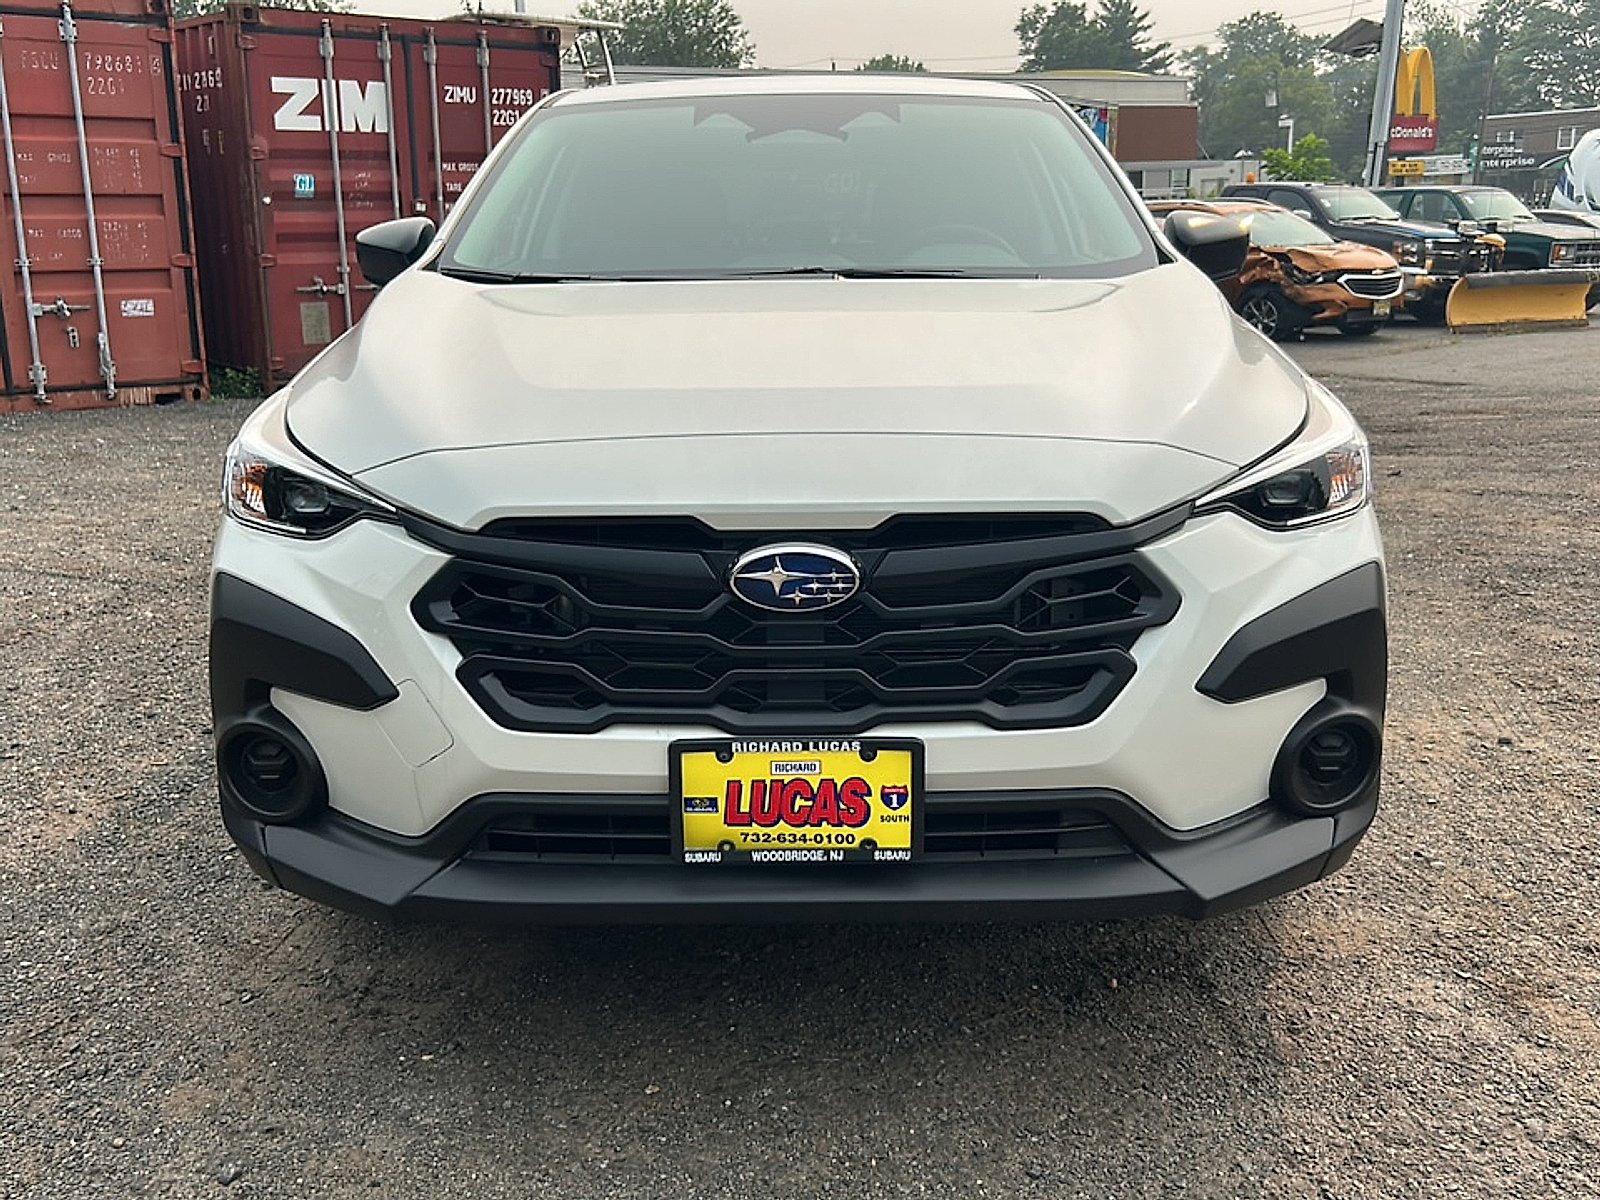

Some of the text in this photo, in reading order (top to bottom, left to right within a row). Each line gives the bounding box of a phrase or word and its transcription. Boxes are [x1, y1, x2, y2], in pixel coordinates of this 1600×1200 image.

[443, 85, 477, 104] ZIMU
[491, 88, 534, 105] 277969
[271, 76, 389, 133] ZIM
[493, 109, 521, 127] 22G1
[1390, 126, 1433, 138] cDonald's
[1479, 157, 1535, 169] nterprise
[732, 741, 862, 753] RICHARD LUCAS
[774, 763, 817, 773] RICHARD
[724, 776, 873, 829] LUCAS
[889, 793, 900, 808] 1
[880, 814, 910, 823] SOUTH
[740, 832, 856, 846] 732-634-0100
[684, 851, 722, 863] SUBARU
[829, 849, 845, 861] NJ
[873, 850, 912, 861] SUBARU
